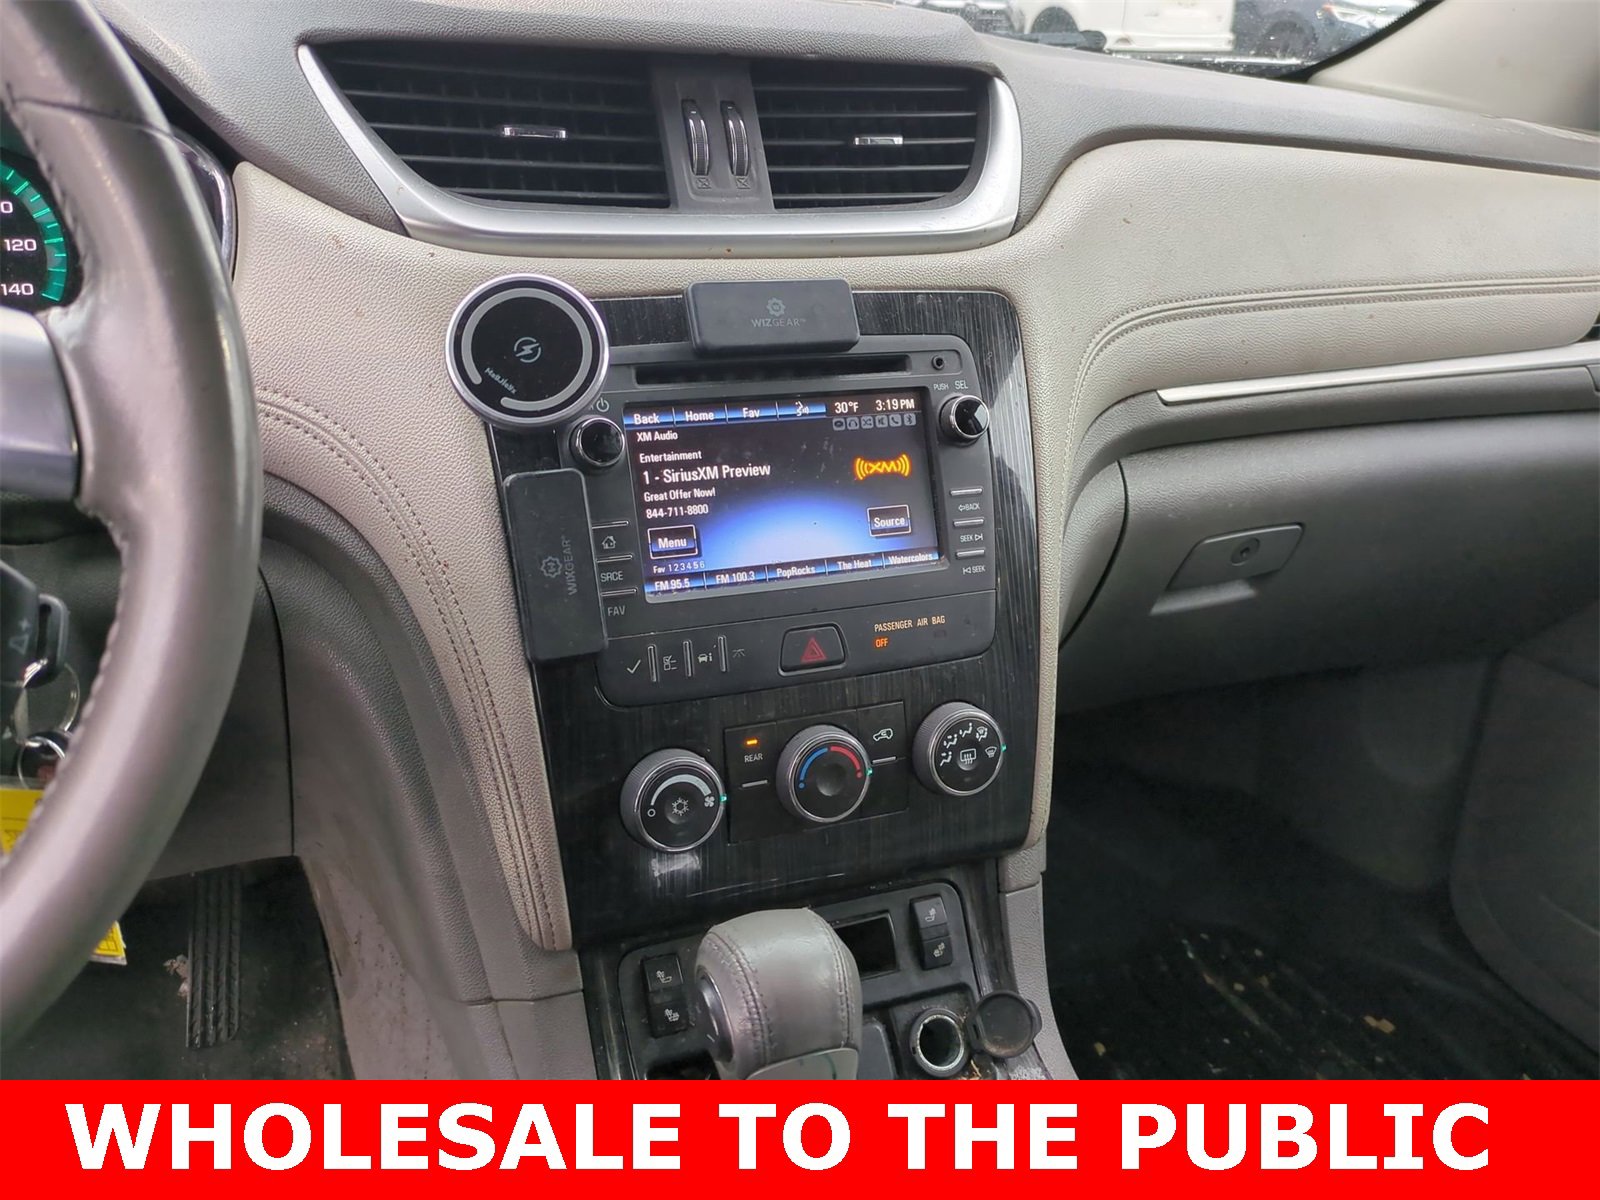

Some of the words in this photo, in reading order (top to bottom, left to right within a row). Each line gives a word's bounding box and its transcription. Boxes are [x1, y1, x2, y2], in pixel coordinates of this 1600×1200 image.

[4, 239, 37, 251] 120
[1, 283, 34, 296] 140
[954, 380, 968, 390] SEL
[633, 413, 660, 425] Back
[685, 410, 714, 422] Home
[742, 407, 760, 419] Fav
[636, 431, 652, 442] XM
[654, 430, 678, 441] Audio
[639, 450, 702, 464] Entertainment
[643, 470, 650, 485] 1
[663, 466, 719, 483] SiriusXM
[722, 463, 771, 479] Preview
[644, 490, 669, 502] Great
[669, 488, 692, 500] Offer
[693, 487, 716, 498] Now!
[646, 504, 709, 519] 844-711-8800
[873, 515, 906, 528] Source
[657, 537, 687, 549] Menu
[960, 534, 973, 542] SEEK
[837, 560, 852, 571] The
[853, 558, 872, 569] Heat
[888, 552, 934, 565] Watercolors
[653, 566, 665, 574] Fav
[776, 564, 816, 578] PopRocks
[972, 565, 985, 573] SEEK
[600, 571, 624, 583] SRCE
[716, 573, 730, 584] FM
[731, 570, 756, 582] 100.3
[655, 580, 669, 591] FM
[670, 578, 690, 589] 95.5
[607, 606, 626, 617] FAV
[874, 619, 913, 632] PASSENGER
[917, 618, 929, 627] AIR
[931, 615, 946, 625] BAG
[875, 638, 889, 648] OFF
[744, 753, 763, 763] REAR
